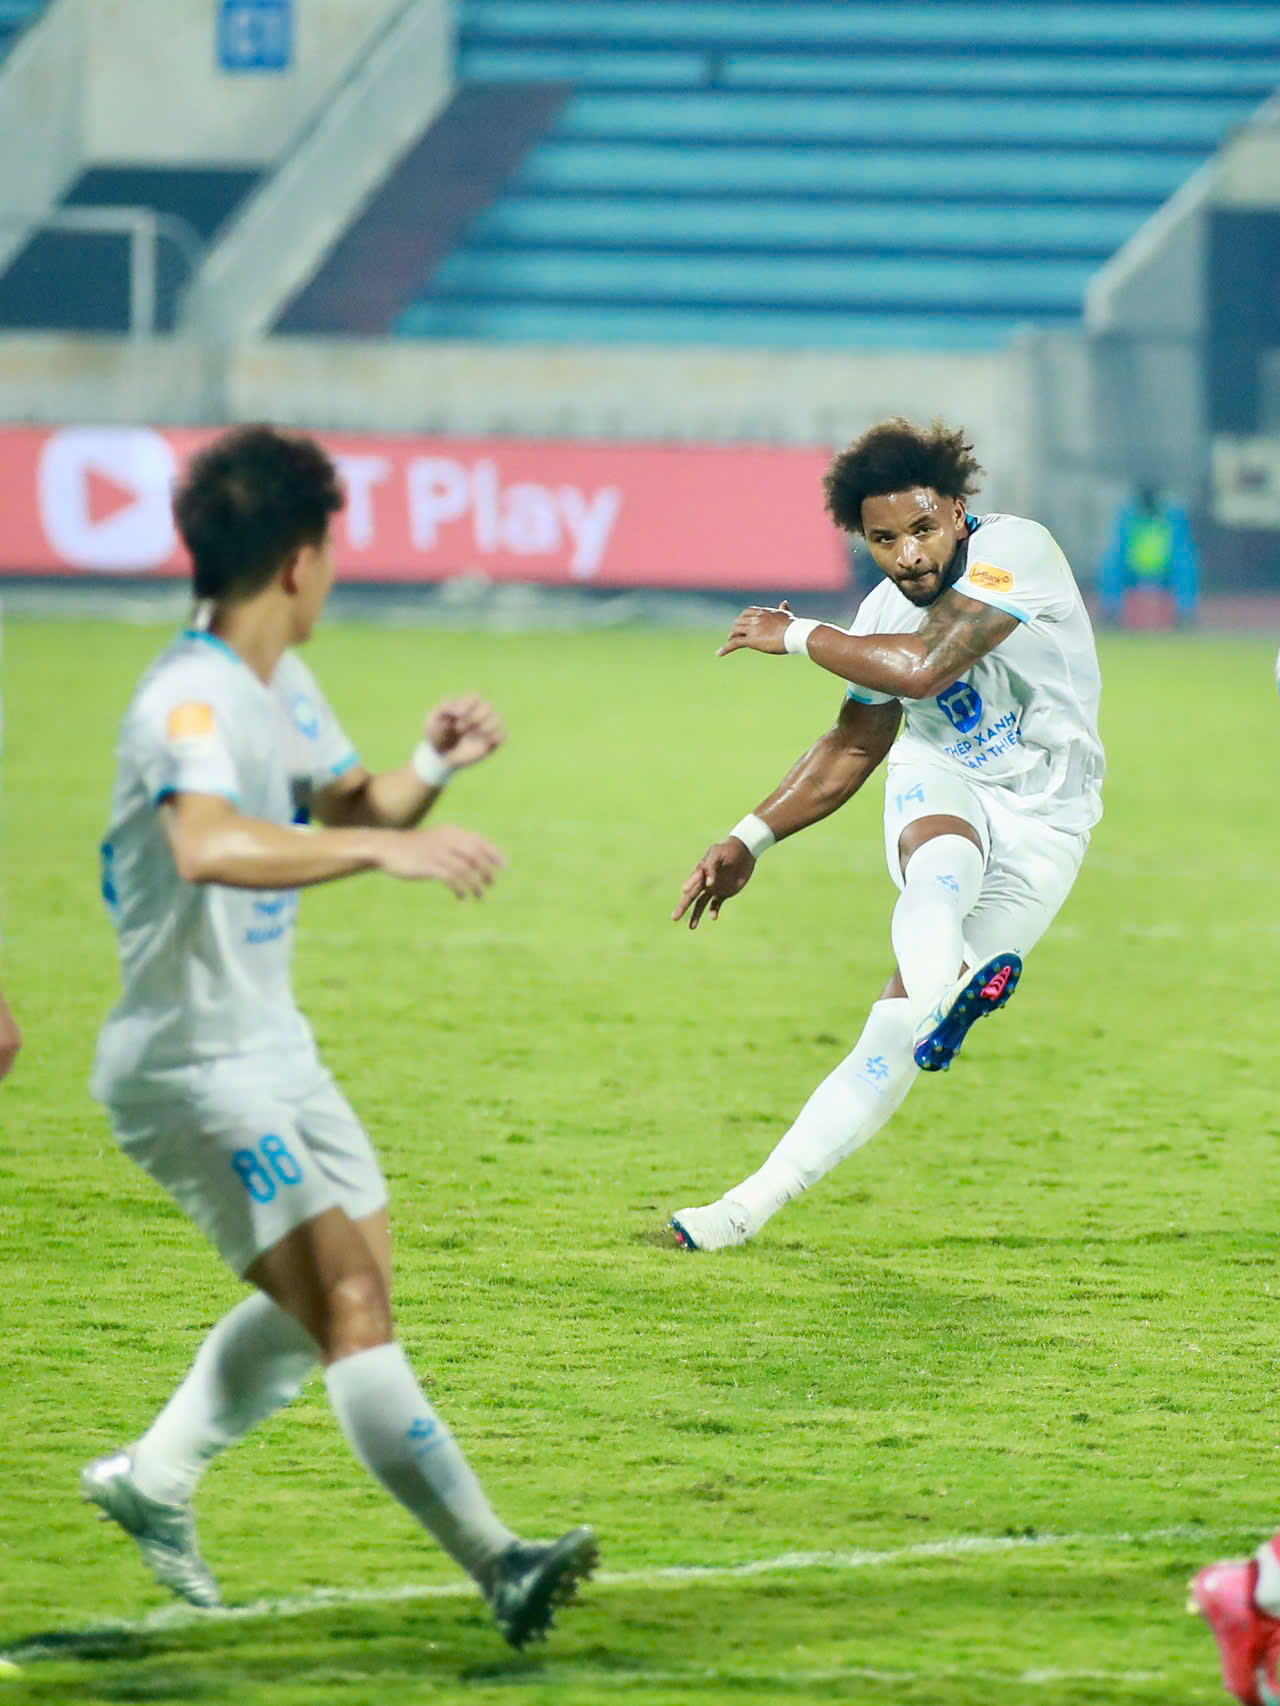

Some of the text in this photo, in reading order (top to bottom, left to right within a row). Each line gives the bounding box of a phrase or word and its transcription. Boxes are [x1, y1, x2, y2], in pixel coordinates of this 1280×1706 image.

[405, 456, 623, 579] Play
[973, 711, 1017, 746] XANH
[231, 1134, 303, 1204] 88
